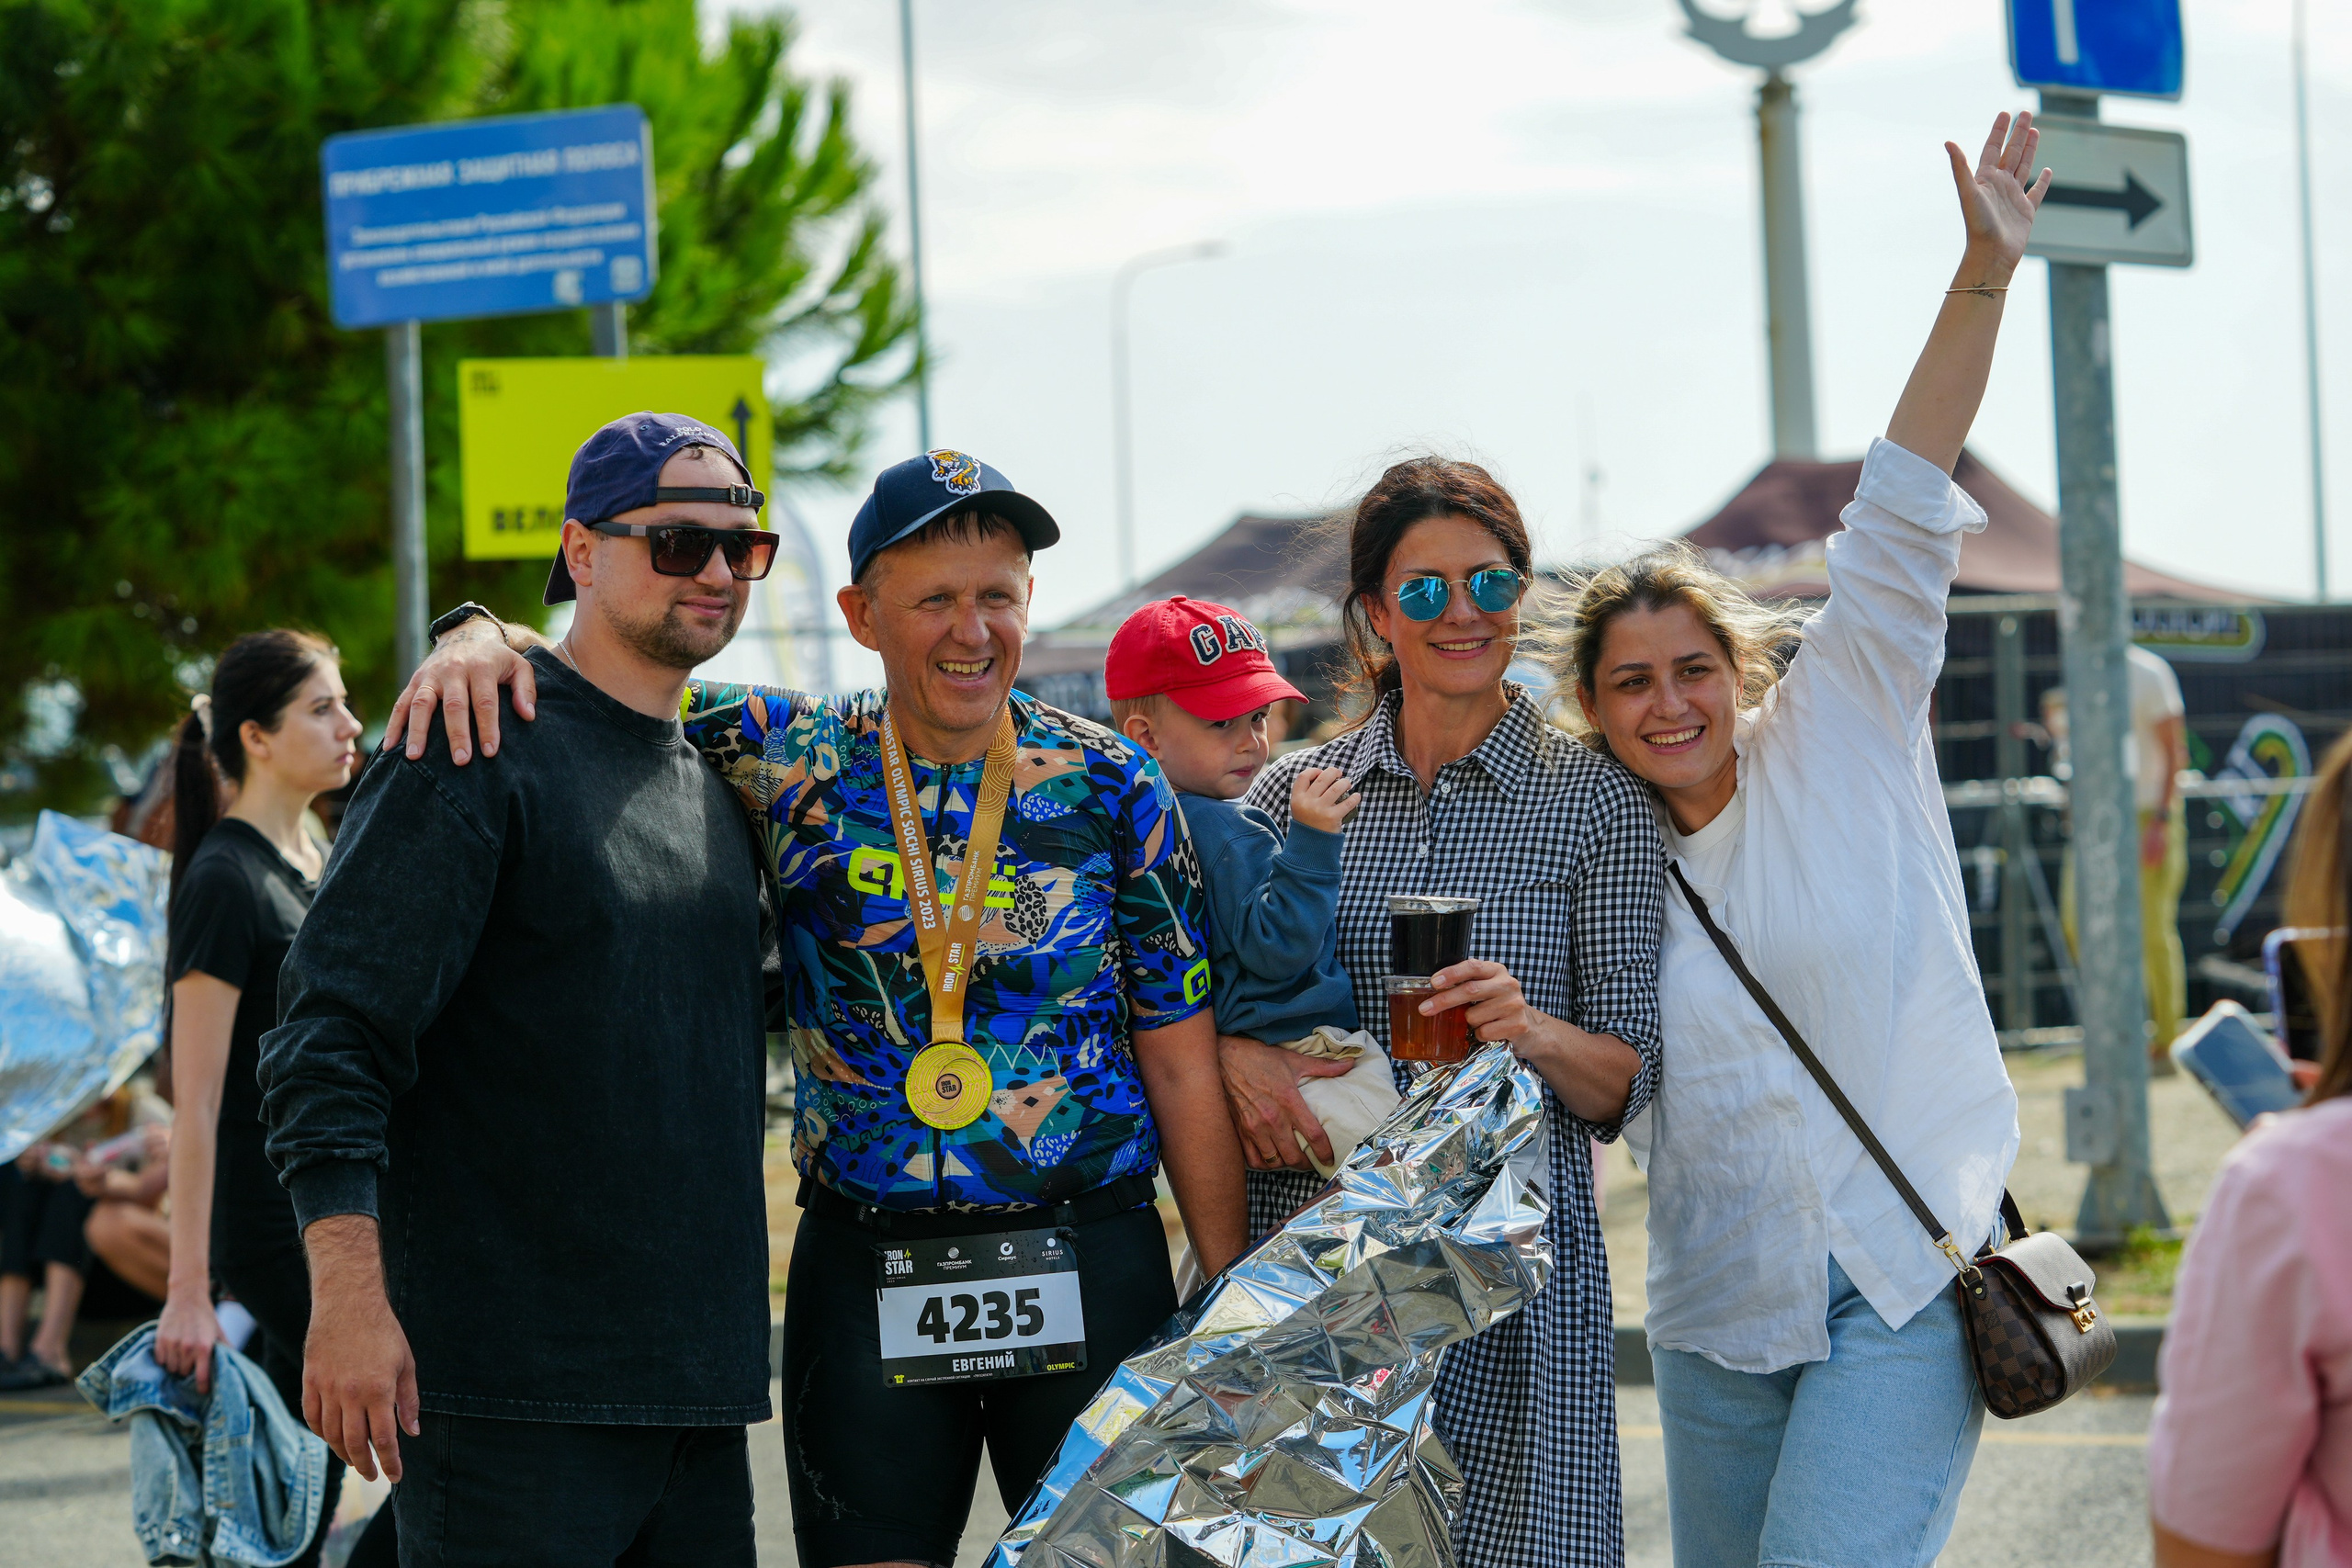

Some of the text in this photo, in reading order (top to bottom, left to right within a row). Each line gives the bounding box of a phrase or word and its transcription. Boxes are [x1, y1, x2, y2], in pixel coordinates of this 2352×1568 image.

[659, 431, 690, 446] RALPH
[883, 709, 937, 930] IRONSTAR OLYMPIC SOCHI SIRIUS 2023
[963, 850, 980, 901] ГАЗПРОМБАНК
[969, 867, 983, 902] ПРЕМИУМ
[942, 942, 962, 992] IRON STAR
[942, 1085, 956, 1094] STAR
[885, 1260, 913, 1275] STAR
[917, 1287, 1044, 1344] 4235
[952, 1351, 1015, 1372] ЕВГЕНИЙ
[1047, 1362, 1075, 1371] OLYMPIC
